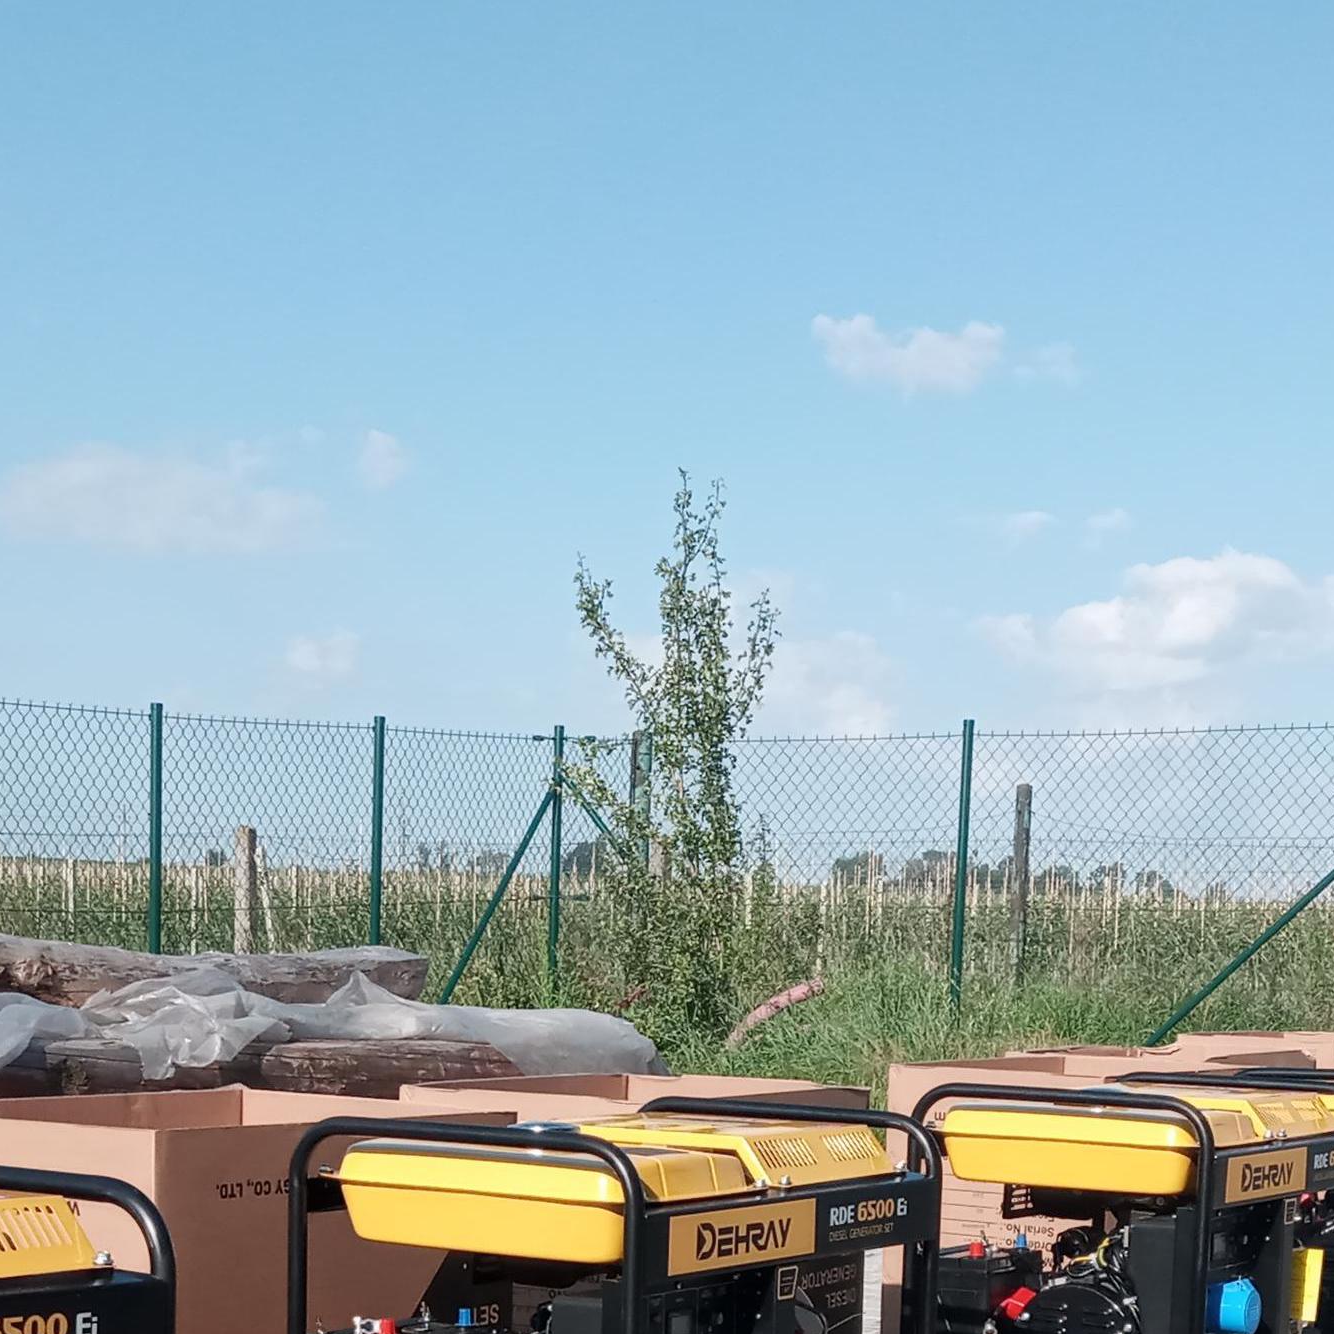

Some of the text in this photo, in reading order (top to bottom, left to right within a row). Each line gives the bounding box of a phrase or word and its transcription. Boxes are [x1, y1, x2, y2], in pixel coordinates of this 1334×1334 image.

[215, 1182, 244, 1199] LTD.
[1241, 1160, 1294, 1192] DEHRAY
[829, 1204, 856, 1227] RDE
[857, 1198, 895, 1222] 6500
[696, 1217, 792, 1261] DEHRAY
[1029, 1240, 1053, 1253] Orde
